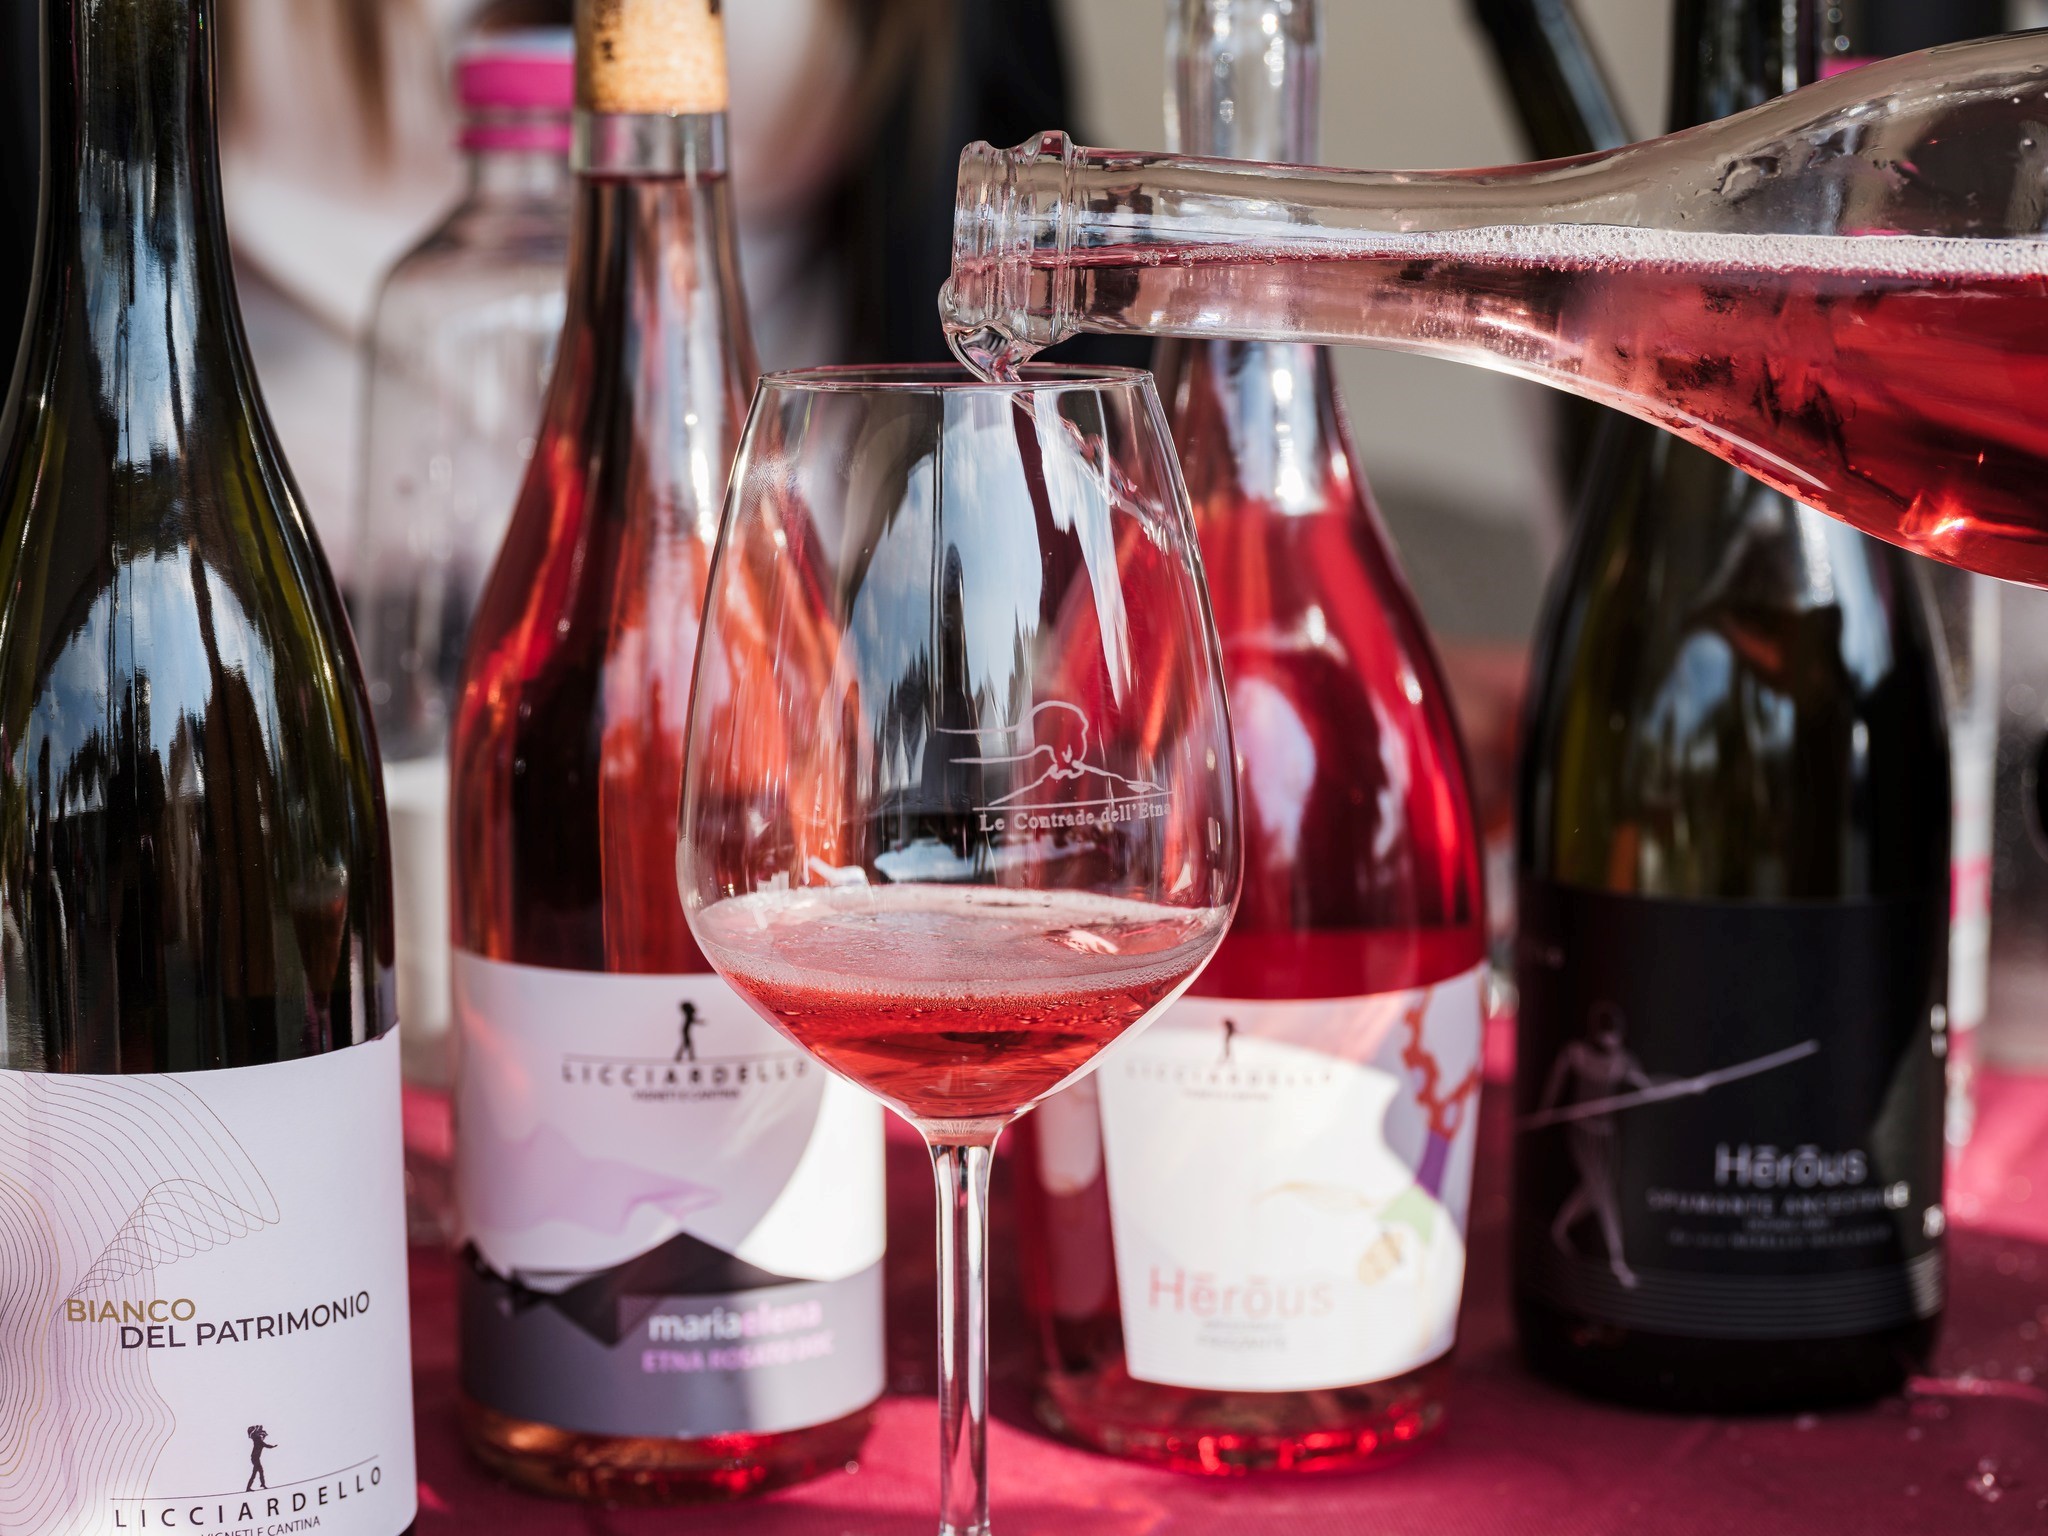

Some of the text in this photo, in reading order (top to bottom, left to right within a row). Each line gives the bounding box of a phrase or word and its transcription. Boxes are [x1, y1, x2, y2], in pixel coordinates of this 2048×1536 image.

[979, 814, 1005, 832] Le
[1014, 808, 1095, 831] Contrade
[66, 1298, 196, 1323] BIANCO
[121, 1290, 370, 1349] DEL PATRIMONIO
[115, 1466, 382, 1528] LICCIARDELLO
[267, 1516, 321, 1536] CANTINA
